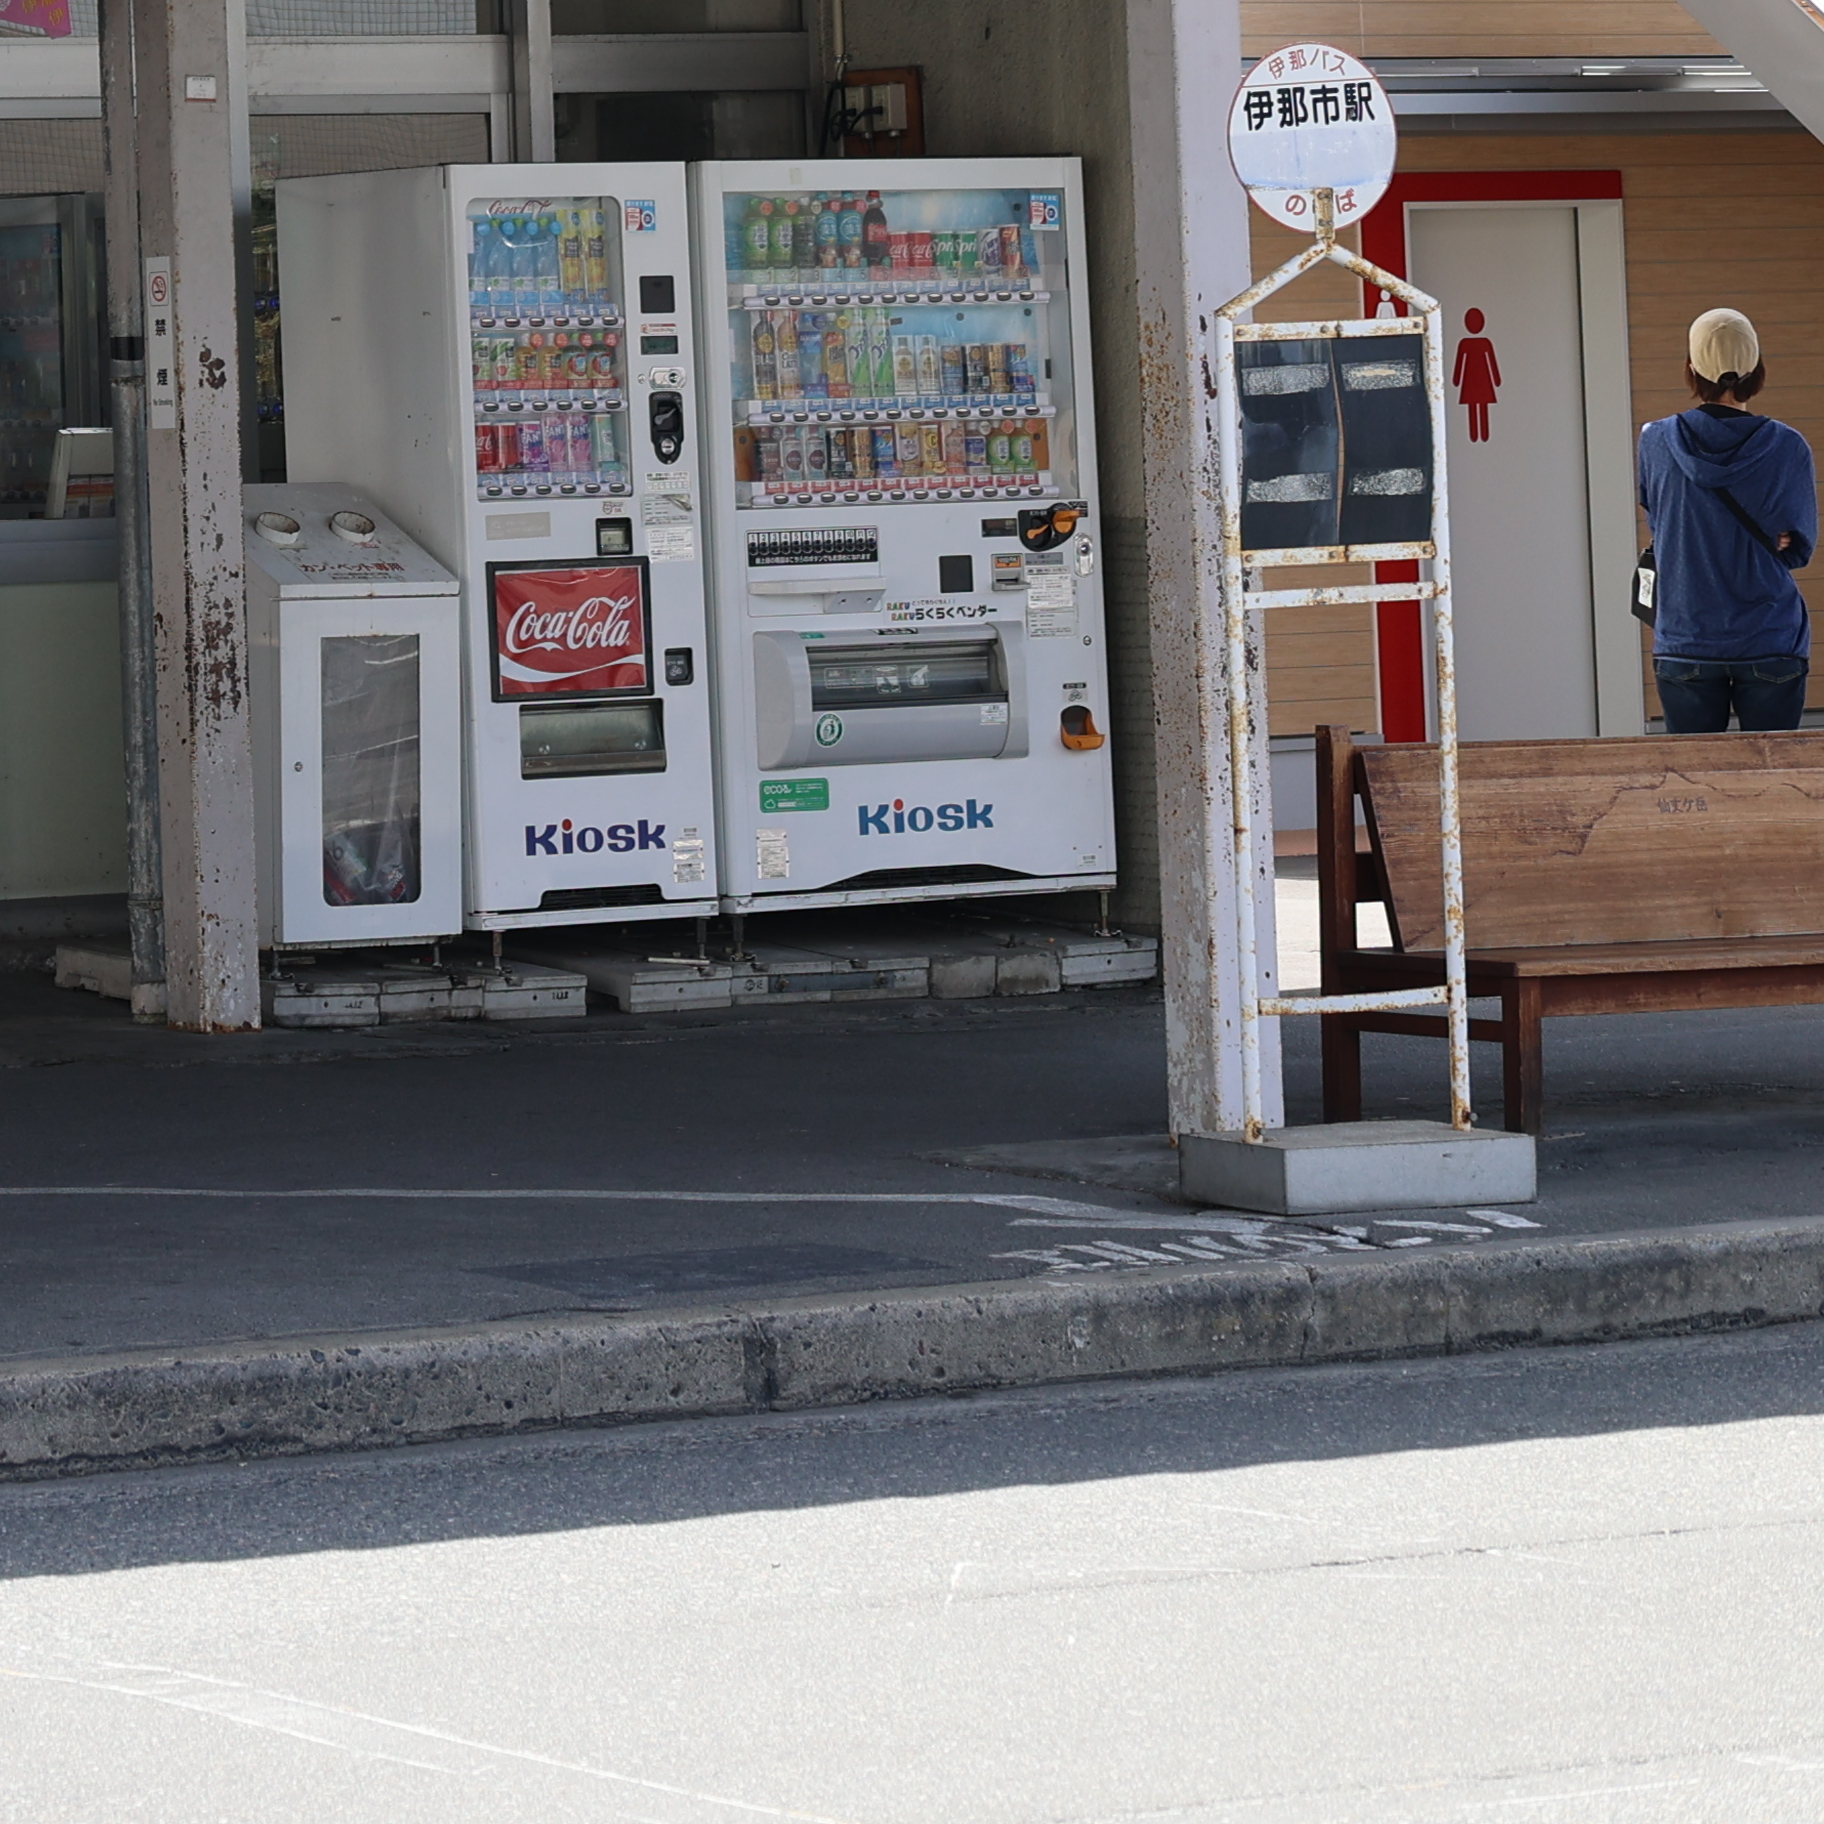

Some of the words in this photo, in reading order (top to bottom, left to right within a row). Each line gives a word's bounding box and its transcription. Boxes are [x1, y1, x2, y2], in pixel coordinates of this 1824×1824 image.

[1268, 48, 1346, 80] 伊那バス
[1244, 81, 1375, 132] 伊那市駅
[1285, 188, 1358, 217] のば
[154, 318, 169, 386] 禁煙
[506, 595, 637, 654] Coca-Cola
[886, 601, 910, 611] RAKU
[891, 612, 915, 622] RAKU
[915, 605, 998, 621] らくらくベンダー
[857, 798, 995, 836] Kiosk
[525, 818, 667, 857] Kiosk
